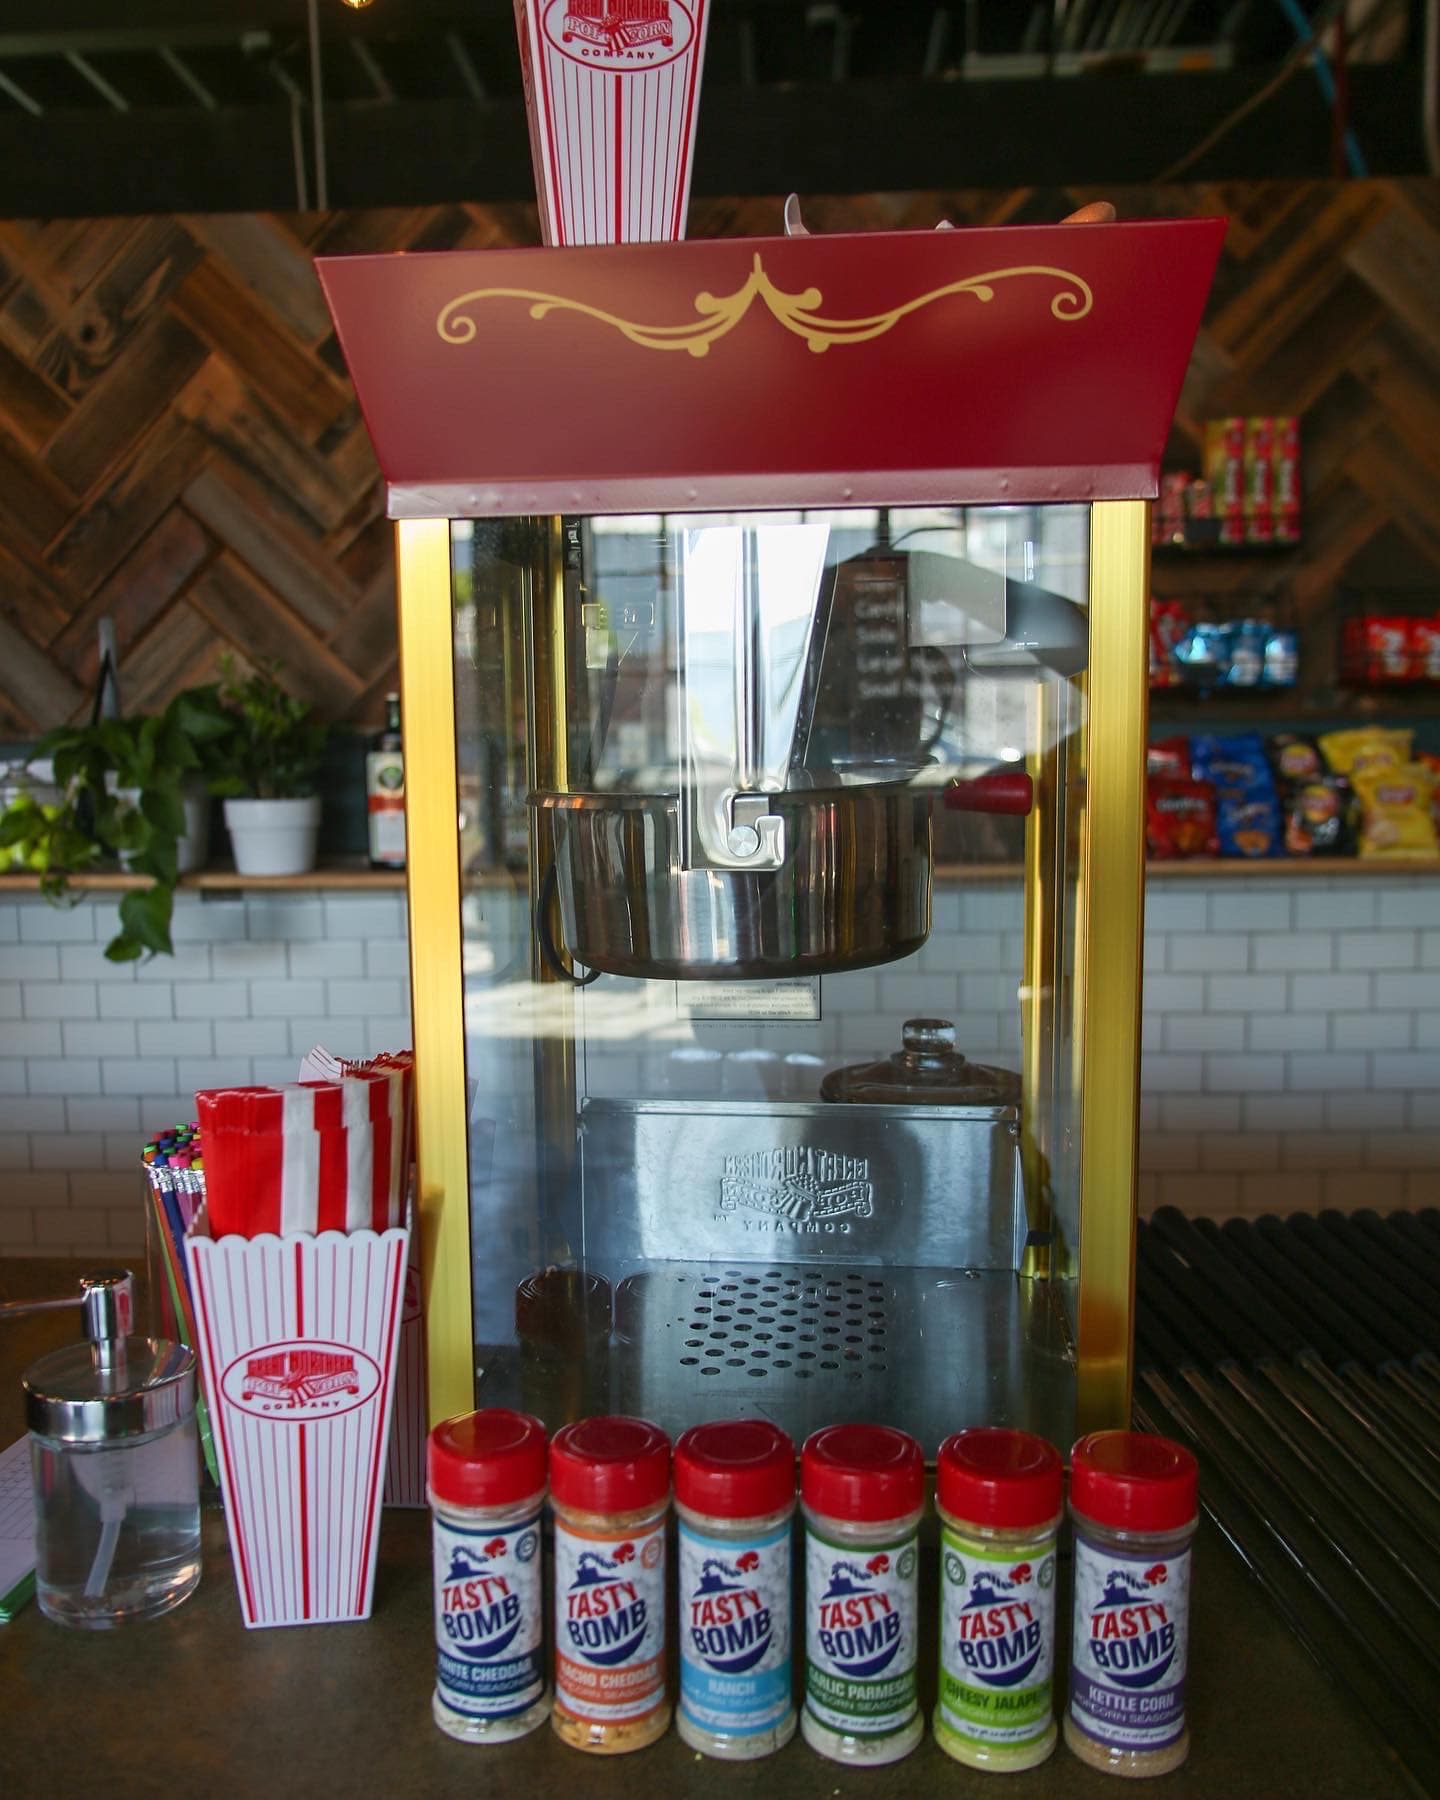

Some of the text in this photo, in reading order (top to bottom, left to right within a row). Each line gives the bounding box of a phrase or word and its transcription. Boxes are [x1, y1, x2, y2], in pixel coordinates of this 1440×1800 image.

[581, 48, 655, 59] COMPANY
[262, 1400, 340, 1411] COMPANY
[442, 1575, 511, 1612] TASTY
[567, 1581, 639, 1619] TASTY
[690, 1588, 763, 1627] TASTY
[819, 1592, 892, 1630] TASTY
[442, 1593, 520, 1641] BOMB
[566, 1599, 648, 1648] BOMB
[690, 1607, 771, 1656] BOMB
[818, 1611, 901, 1659] BOMB
[959, 1601, 1034, 1640] TASTY
[1091, 1602, 1168, 1639] TASTY
[958, 1619, 1042, 1669] BOMB
[1089, 1622, 1175, 1670] BOMB
[708, 1678, 757, 1697] RANCH
[1088, 1684, 1175, 1712] KETTLE CORN
